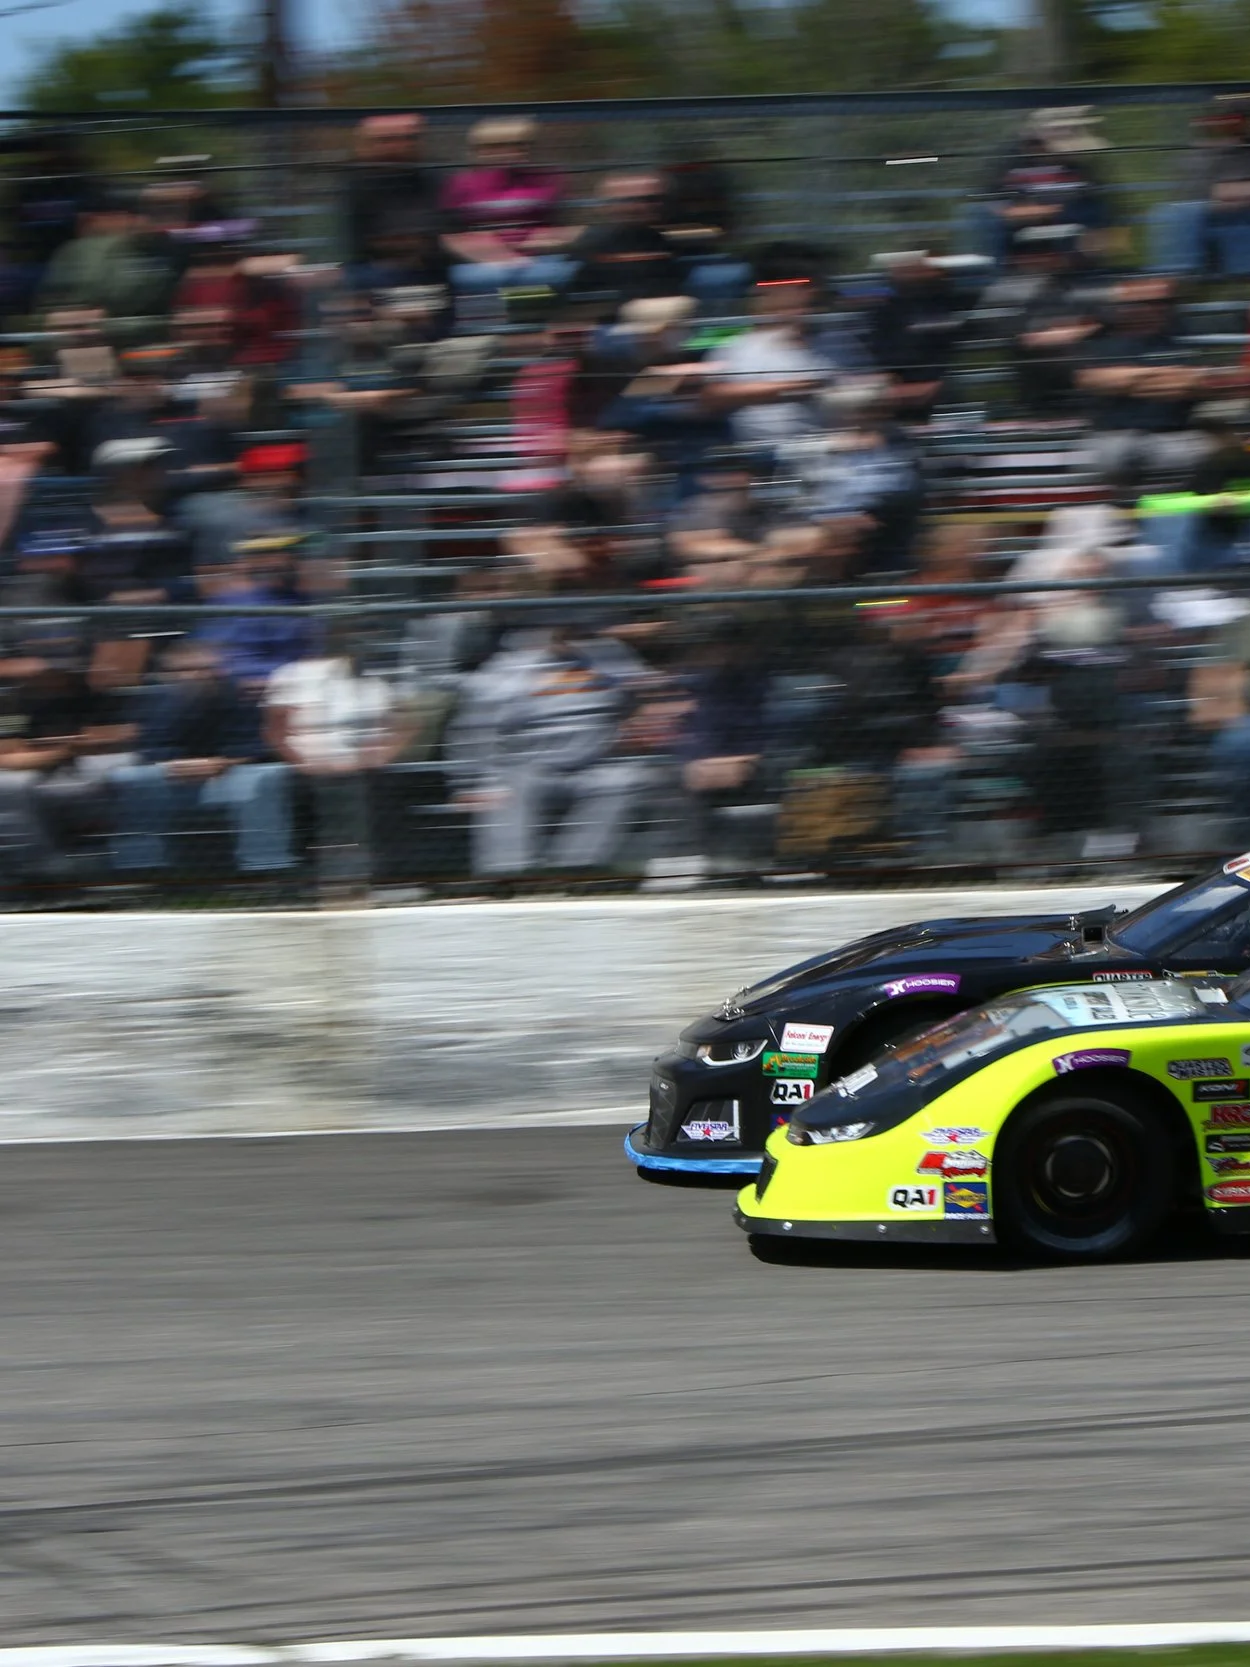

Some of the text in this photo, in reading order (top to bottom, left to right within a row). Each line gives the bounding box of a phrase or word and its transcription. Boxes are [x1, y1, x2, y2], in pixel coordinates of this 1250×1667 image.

[906, 978, 955, 988] HOOSIER
[773, 1084, 811, 1101] QA1
[893, 1188, 936, 1208] QA1
